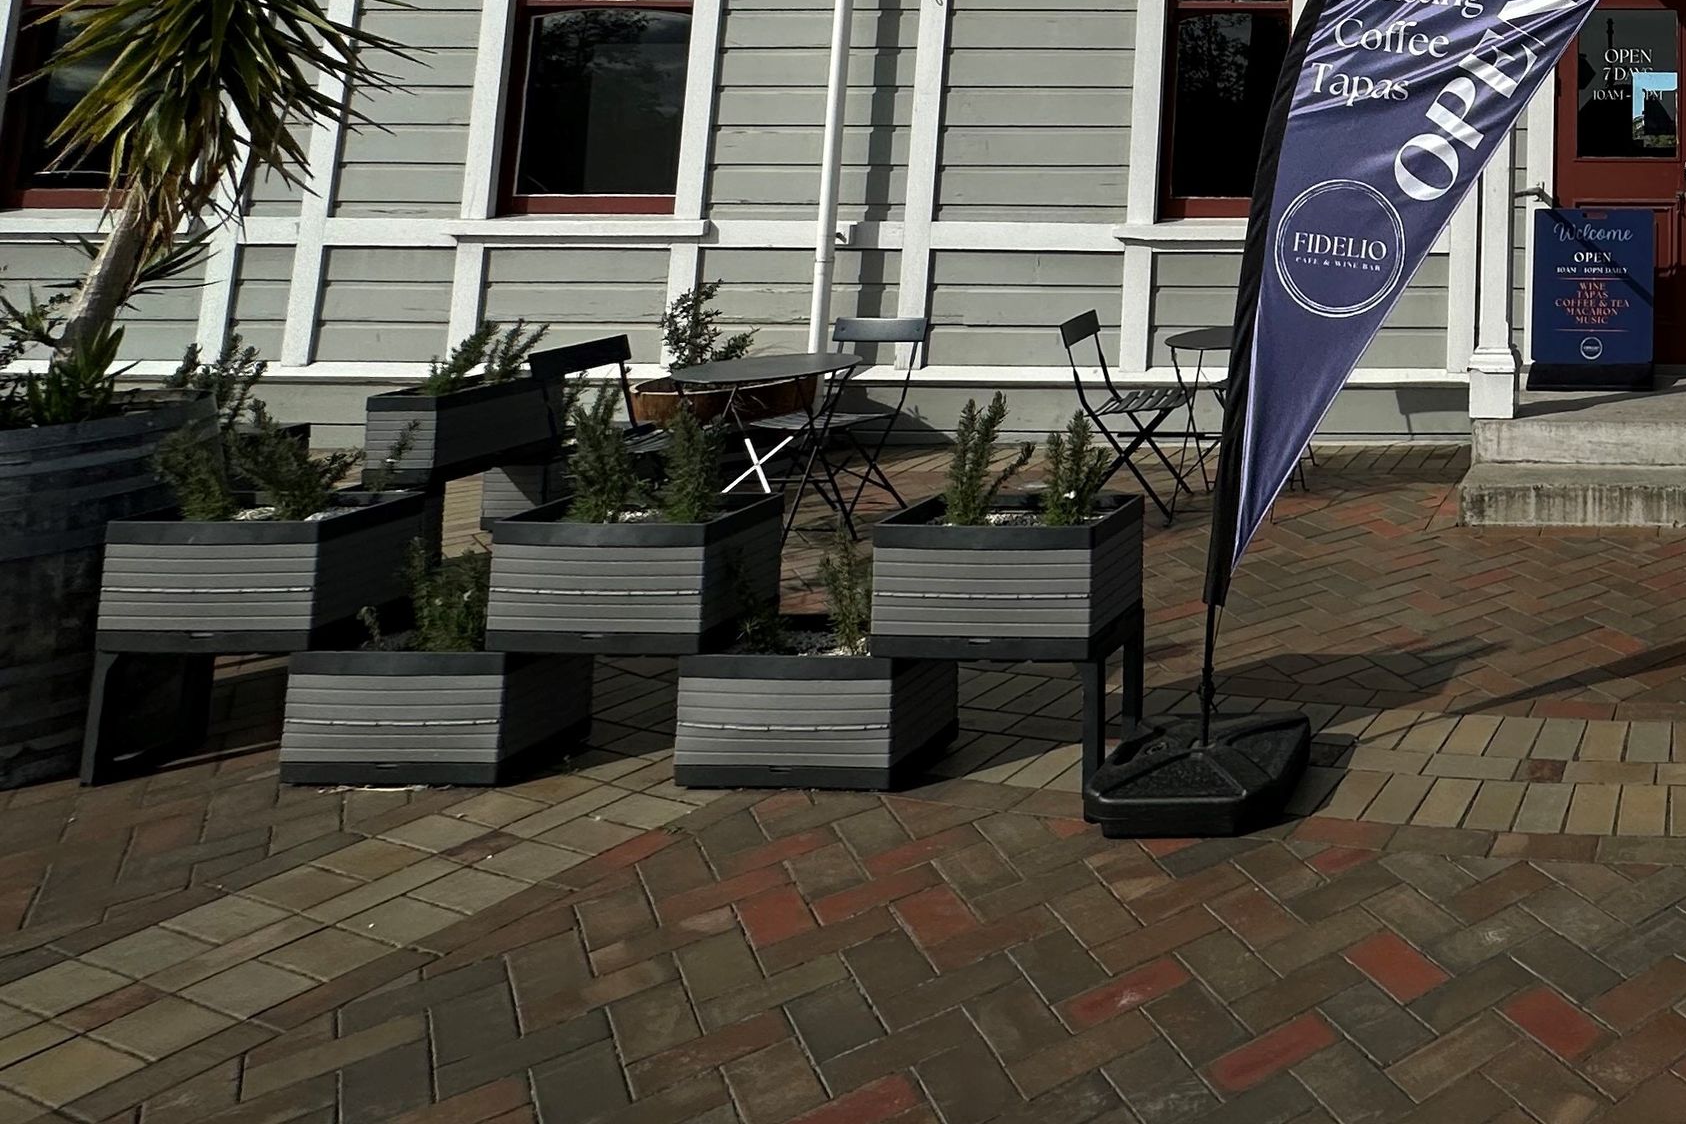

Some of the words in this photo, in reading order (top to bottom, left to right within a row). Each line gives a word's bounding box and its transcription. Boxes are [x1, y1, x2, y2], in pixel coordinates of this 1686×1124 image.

[1335, 18, 1450, 58] Coffee
[1604, 49, 1653, 64] OPEN
[1603, 67, 1611, 81] 7
[1312, 63, 1409, 107] Tapas
[1593, 90, 1624, 101] 10AM
[1553, 222, 1633, 242] Welcome
[1293, 232, 1387, 261] FIDELIO
[1574, 251, 1612, 263] OPEN
[1334, 260, 1359, 269] WINE
[1362, 263, 1381, 271] BAR
[1579, 282, 1606, 290] WINE
[1554, 299, 1596, 307] COFFEE
[1610, 299, 1630, 307] TEA
[1575, 316, 1609, 324] MUSIC
